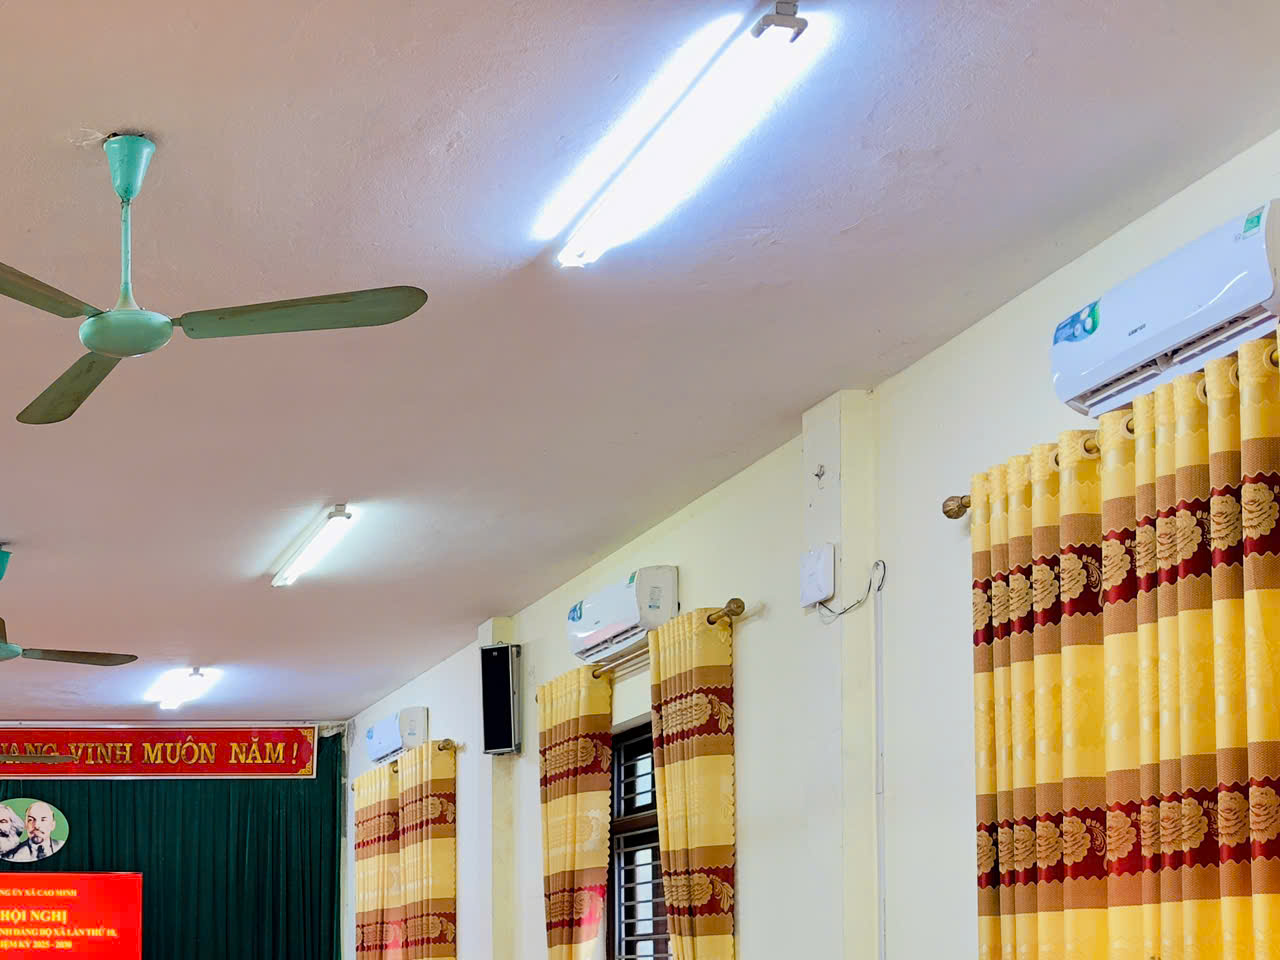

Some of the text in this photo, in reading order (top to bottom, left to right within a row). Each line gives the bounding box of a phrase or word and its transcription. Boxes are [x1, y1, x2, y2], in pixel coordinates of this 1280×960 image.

[67, 742, 134, 765] VINH
[141, 735, 218, 765] MUÔN
[37, 888, 55, 897] CAO
[55, 888, 78, 897] MINH
[0, 907, 68, 925] HỘI NGHỊ
